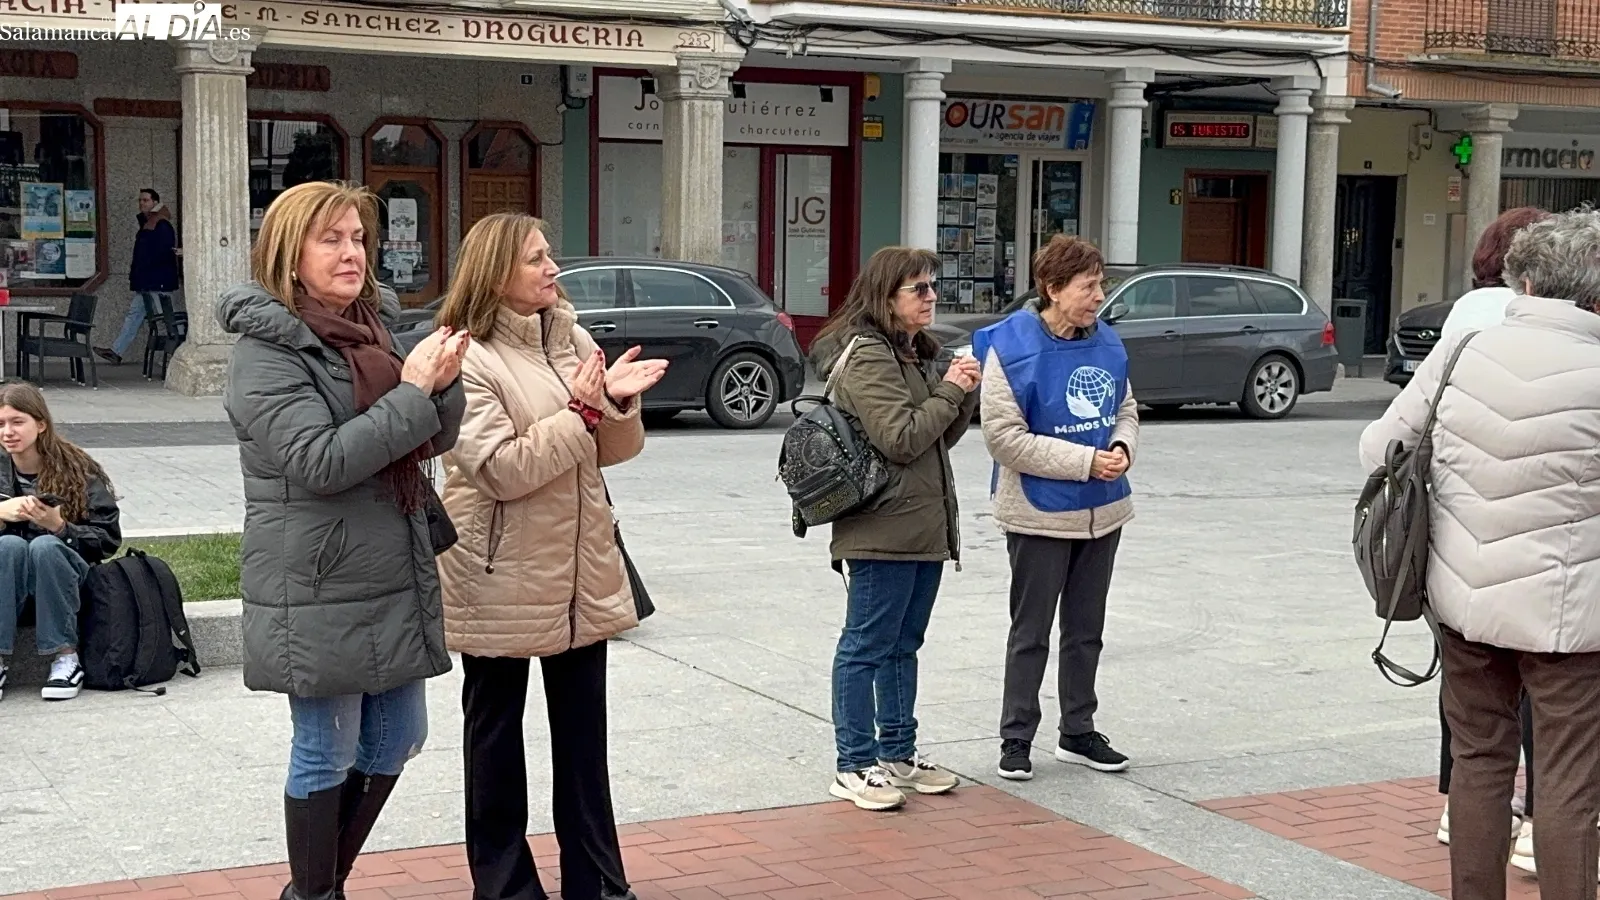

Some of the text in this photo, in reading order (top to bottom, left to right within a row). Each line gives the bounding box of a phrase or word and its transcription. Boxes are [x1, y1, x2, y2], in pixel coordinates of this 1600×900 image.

[301, 9, 441, 36] SANCHEZ
[462, 19, 645, 48] DROGUERIA
[634, 89, 817, 117] Jo utiérrez
[941, 101, 1066, 132] OURsan
[1026, 132, 1036, 141] de
[1501, 139, 1595, 171] rmacia
[787, 196, 826, 225] JG
[1054, 419, 1100, 434] Manos
